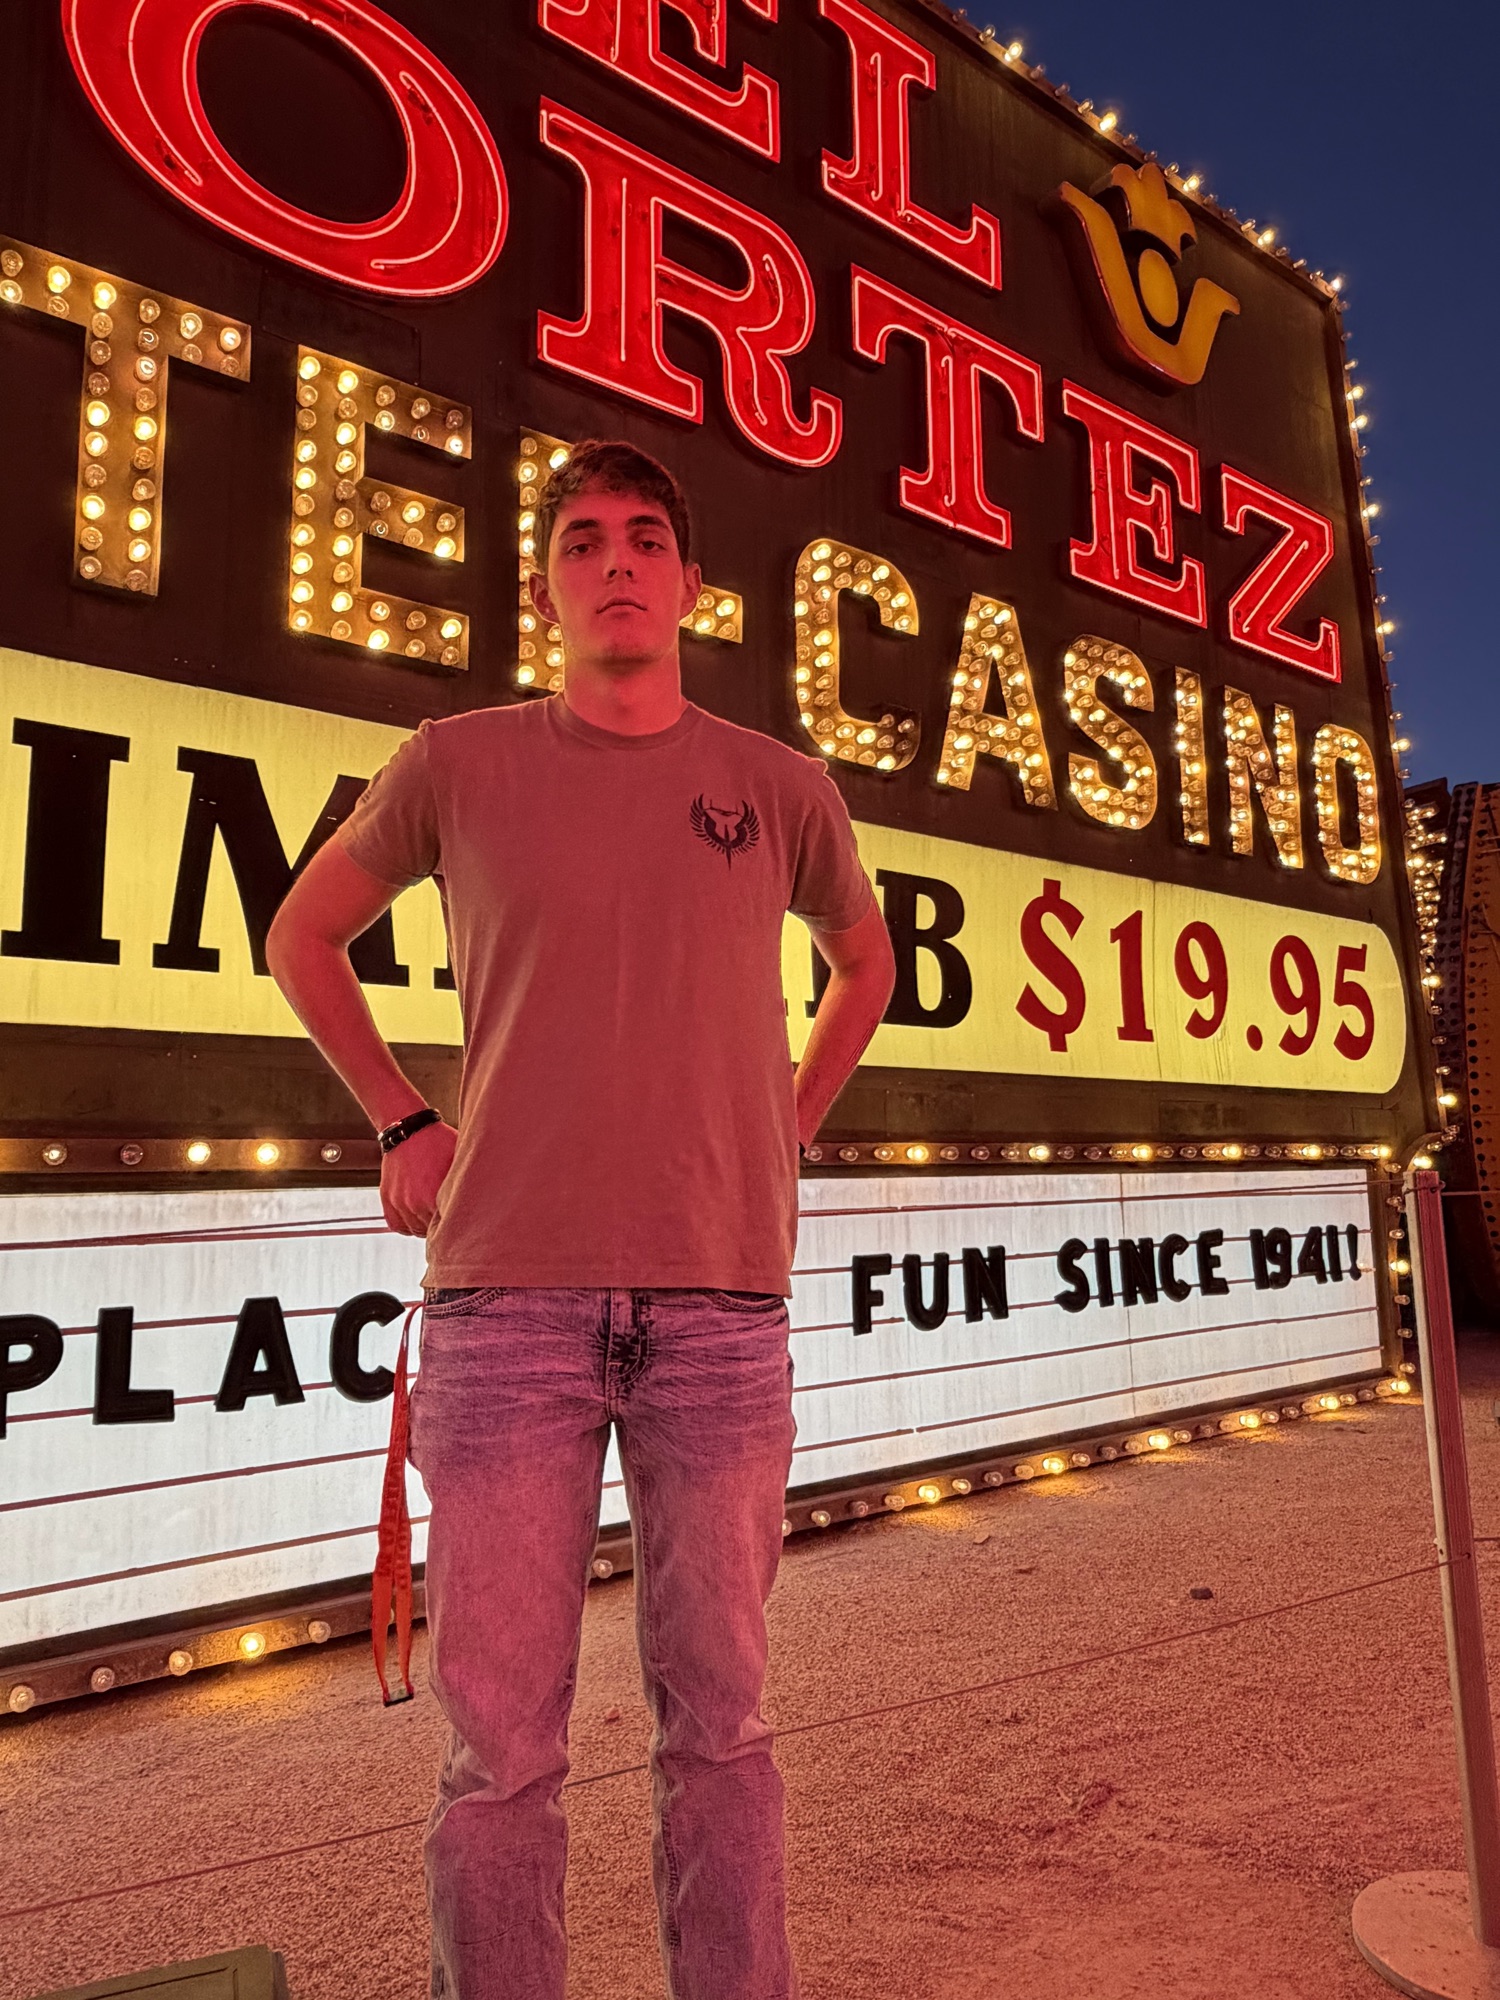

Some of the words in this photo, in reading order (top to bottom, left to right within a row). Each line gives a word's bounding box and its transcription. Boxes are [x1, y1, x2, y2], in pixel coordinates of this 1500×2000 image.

[0, 717, 458, 992] IM
[1015, 877, 1375, 1061] $19.95
[851, 1244, 1009, 1336] FUN
[1054, 1228, 1230, 1312] SINCE
[1249, 1223, 1362, 1290] 1941!
